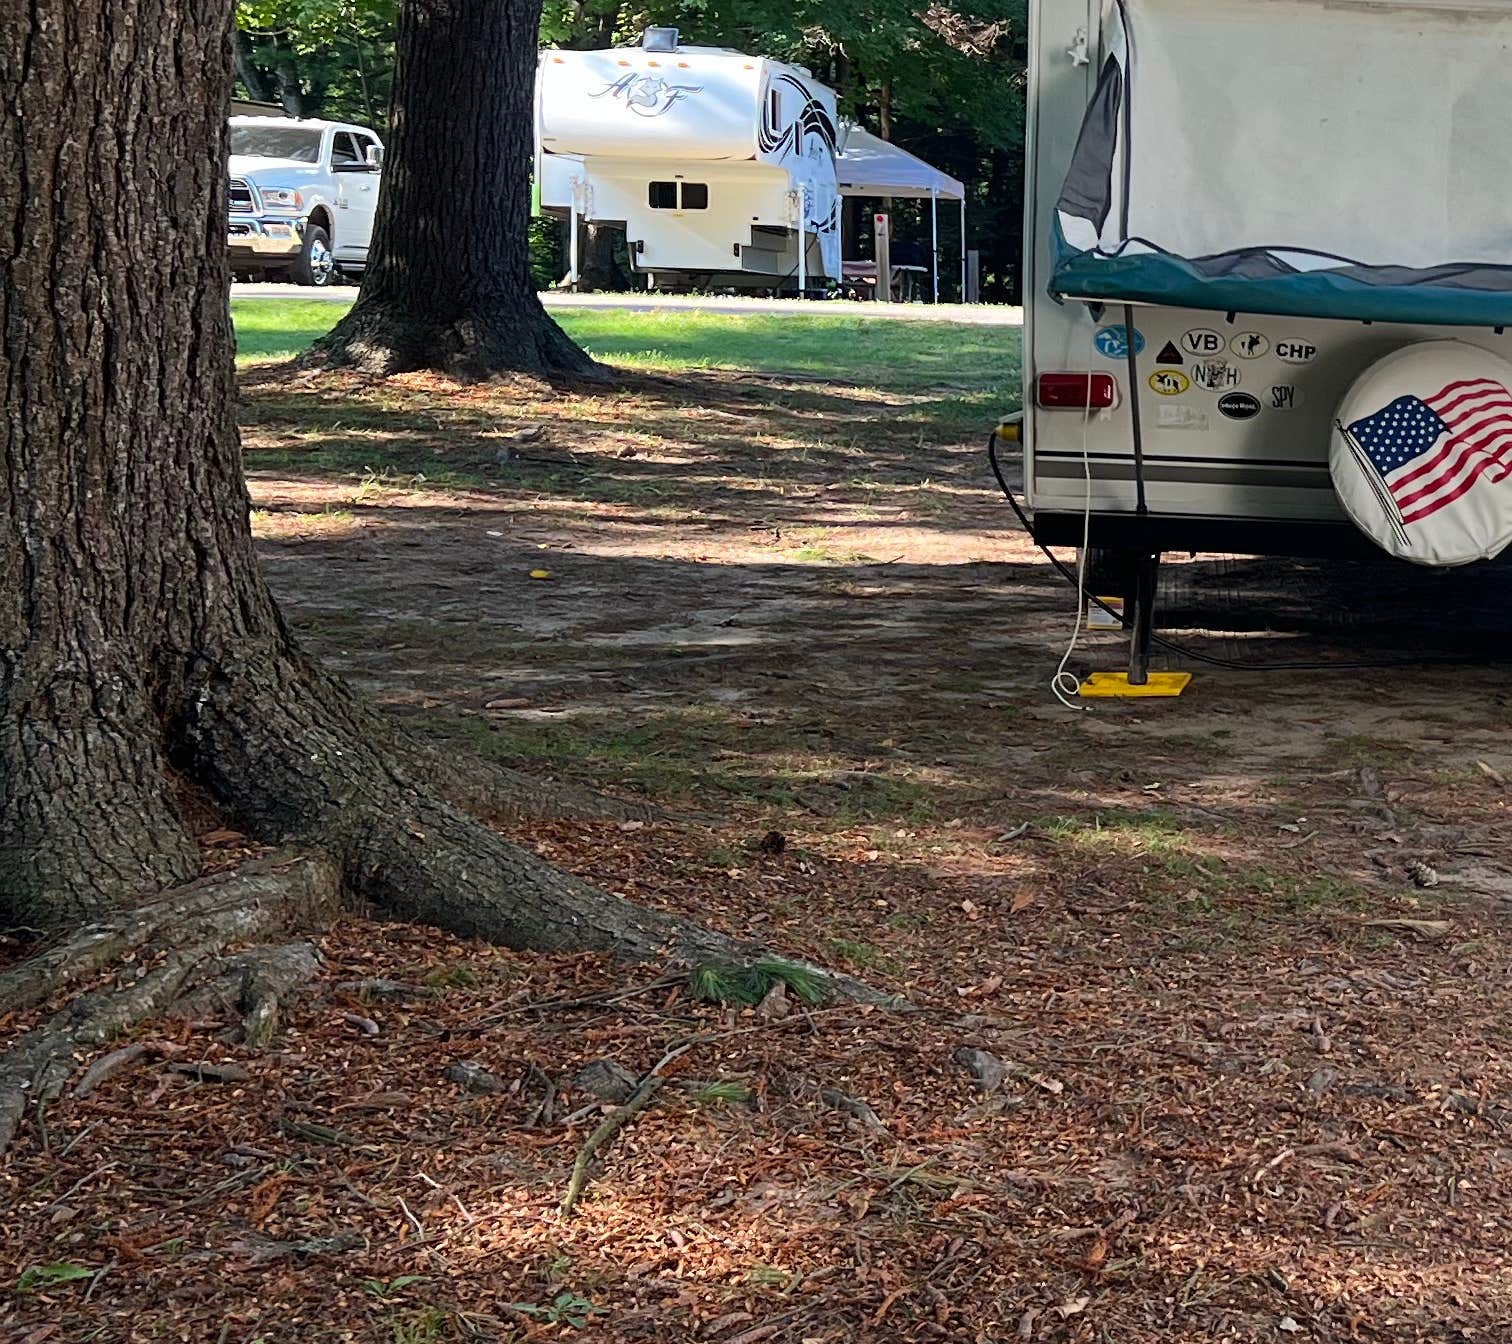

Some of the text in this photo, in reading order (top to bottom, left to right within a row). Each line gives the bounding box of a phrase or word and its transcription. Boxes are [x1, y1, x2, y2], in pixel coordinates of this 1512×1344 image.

[1188, 333, 1219, 351] VB
[1275, 342, 1316, 360] CHP
[1271, 386, 1295, 408] SPY
